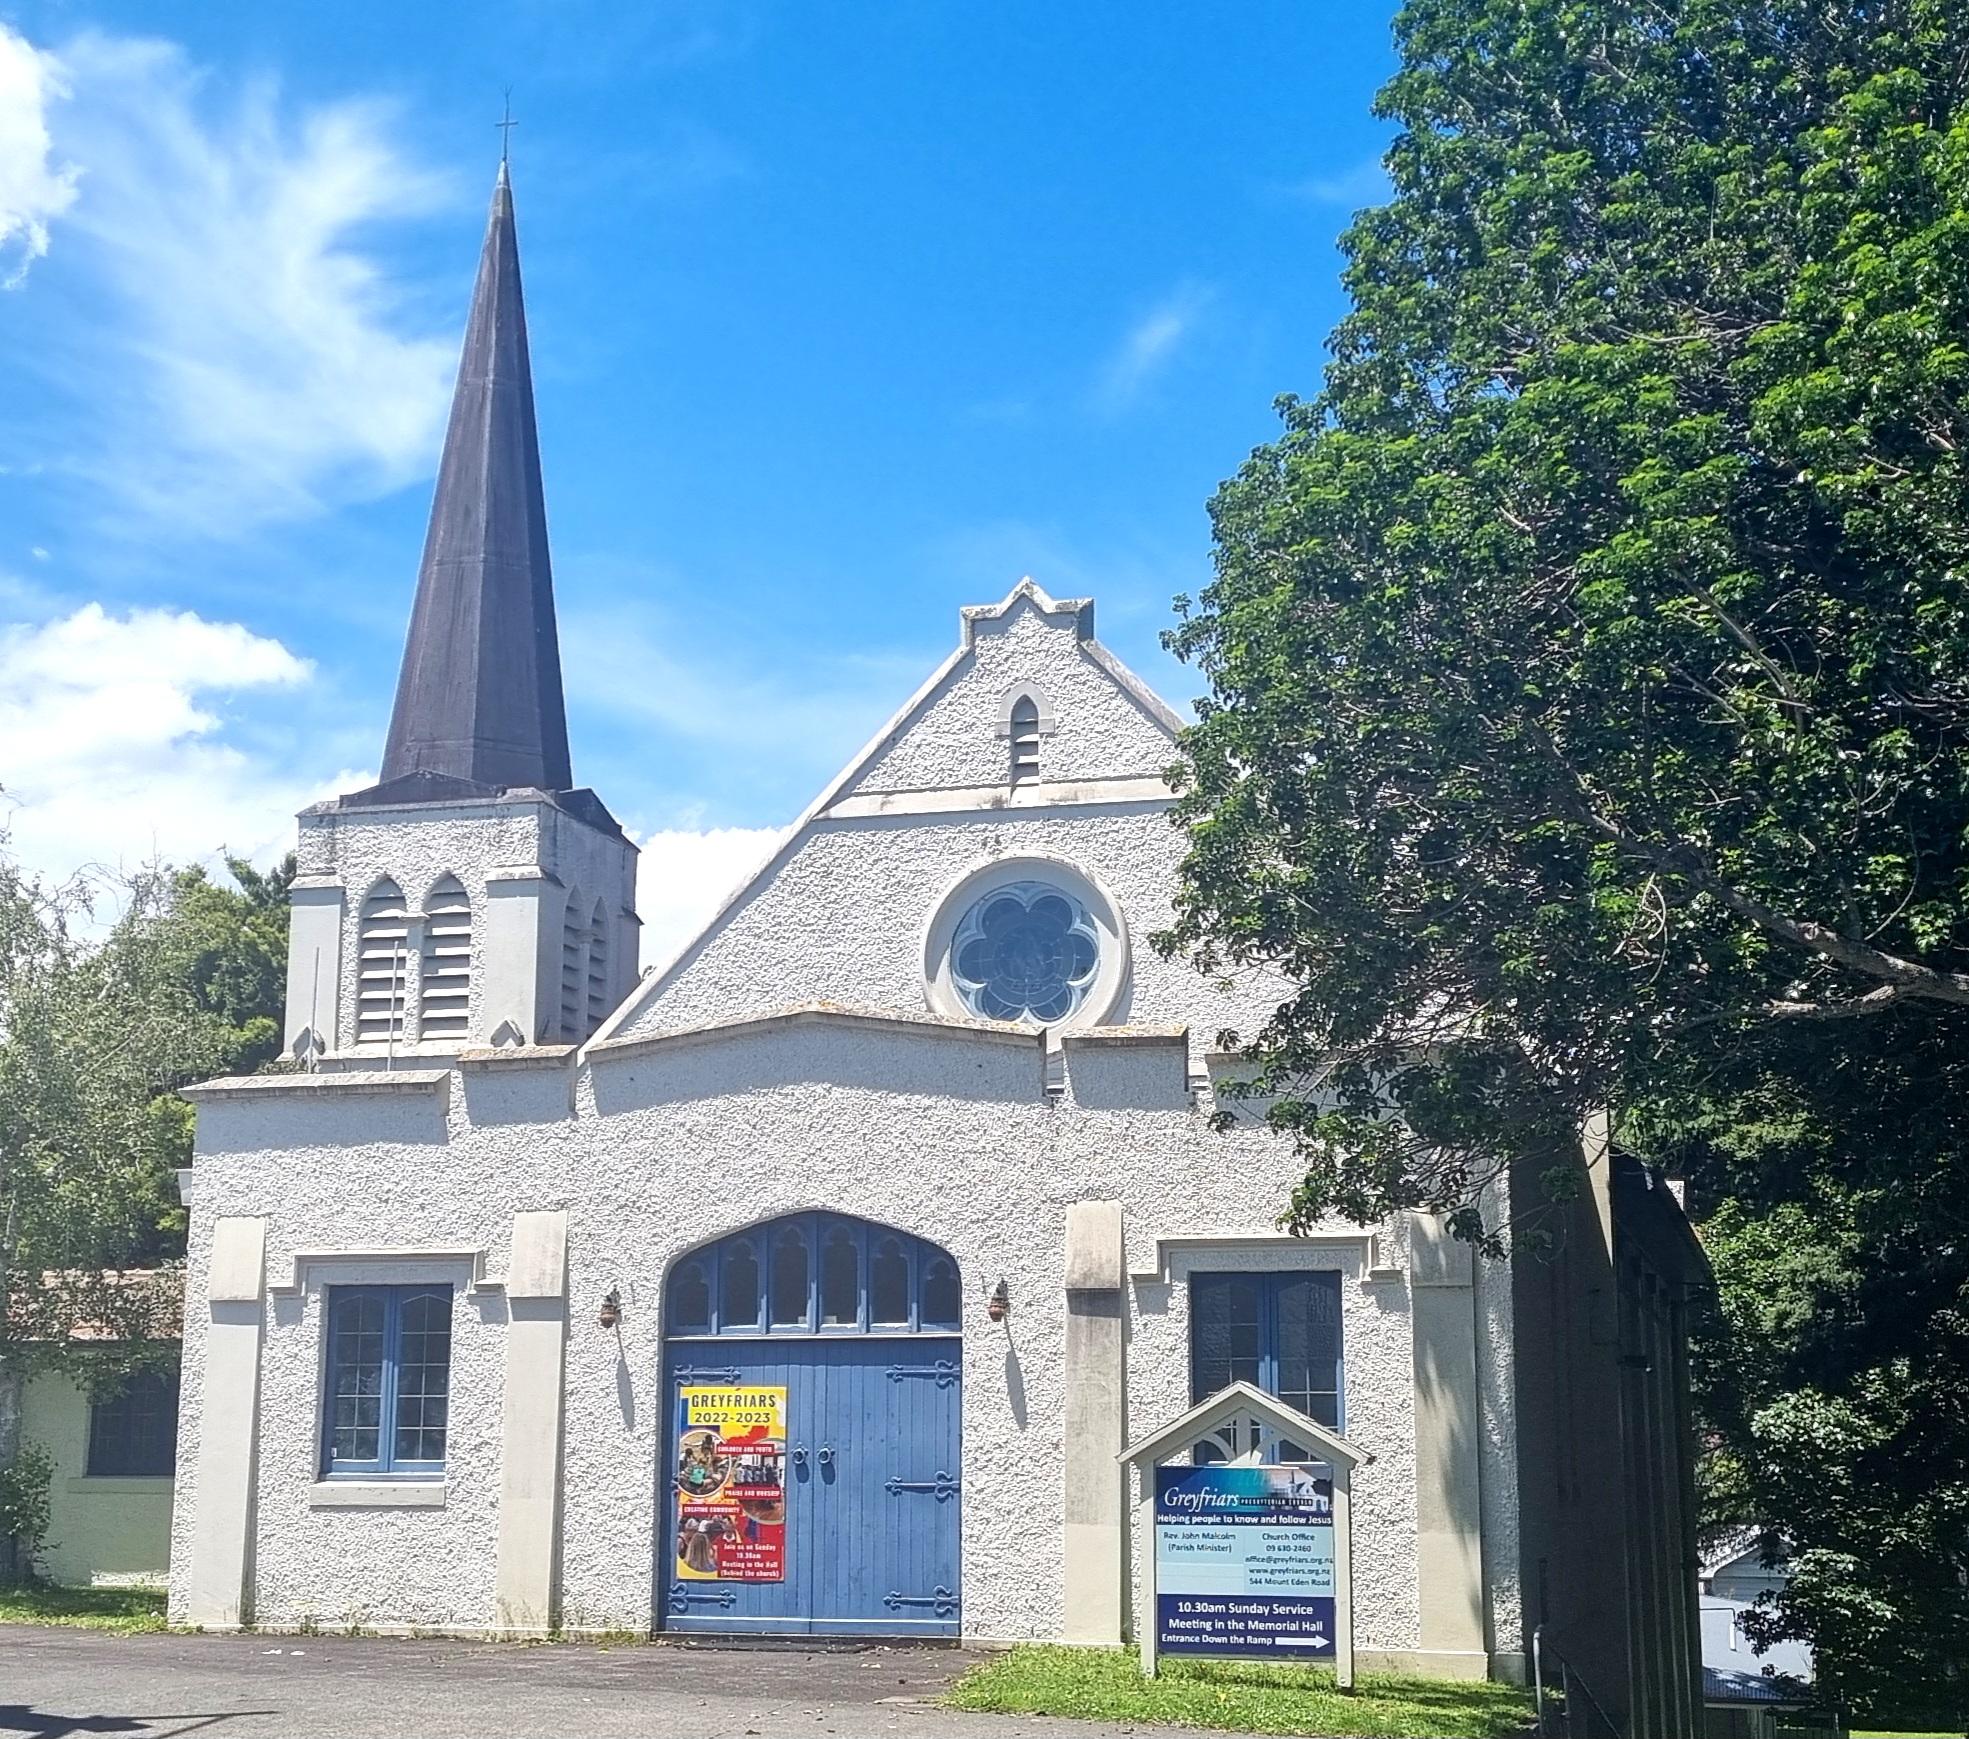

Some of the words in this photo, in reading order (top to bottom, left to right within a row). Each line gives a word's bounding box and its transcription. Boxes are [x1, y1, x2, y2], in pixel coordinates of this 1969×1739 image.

[692, 1395, 776, 1408] GREYFRIARS
[695, 1412, 770, 1423] 2022-2023
[1164, 1486, 1240, 1512] Greyfriars
[1157, 1514, 1190, 1524] Helping
[1192, 1514, 1222, 1524] people
[1224, 1515, 1232, 1523] to
[1234, 1514, 1258, 1524] know
[1260, 1515, 1276, 1524] and
[1278, 1515, 1306, 1524] follow
[1308, 1516, 1332, 1524] Jesus
[1262, 1532, 1290, 1540] Church
[1168, 1544, 1194, 1552] (Parish
[1196, 1544, 1232, 1553] Minister)
[1178, 1602, 1226, 1613] 10.30am
[1228, 1602, 1270, 1616] Sunday
[1272, 1604, 1314, 1614] Service
[1168, 1618, 1212, 1632] Meeting
[1214, 1619, 1224, 1630] in
[1228, 1620, 1245, 1630] the
[1248, 1620, 1299, 1631] Memorial
[1302, 1621, 1323, 1632] Hall
[1162, 1634, 1200, 1642] Entrance
[1202, 1634, 1228, 1644] Down
[1230, 1634, 1244, 1644] the
[1246, 1636, 1272, 1646] Ramp
